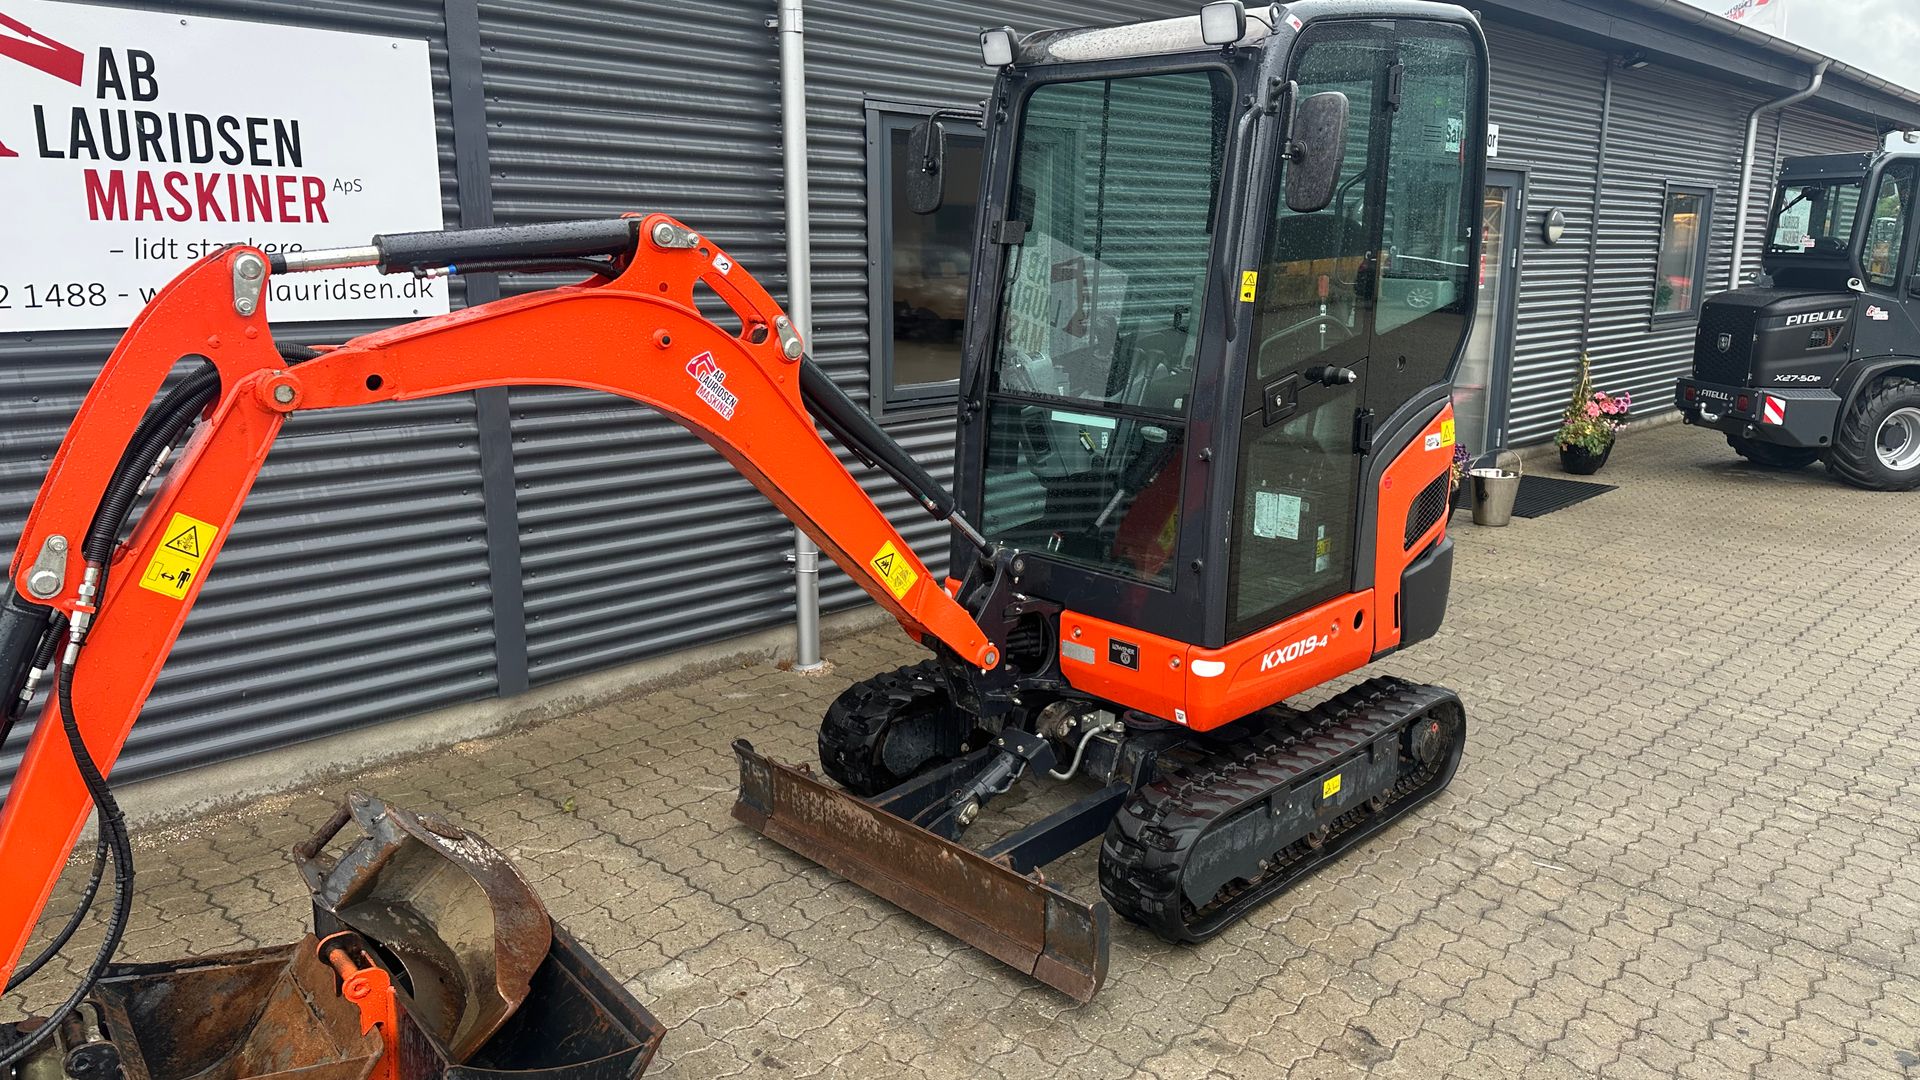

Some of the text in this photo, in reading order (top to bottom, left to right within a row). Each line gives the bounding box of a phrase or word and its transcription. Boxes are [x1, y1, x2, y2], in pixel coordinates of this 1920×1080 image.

[96, 46, 159, 101] AB
[33, 104, 303, 168] LAURIDSEN
[83, 168, 363, 224] MASKINER ApS
[134, 237, 178, 260] lidt
[24, 282, 107, 309] 1488
[1785, 309, 1844, 326] PITBULL
[699, 372, 737, 408] LAURIDSEN
[712, 369, 725, 383] AB
[697, 385, 734, 418] MASKINER
[1260, 634, 1329, 673] KX019-4
